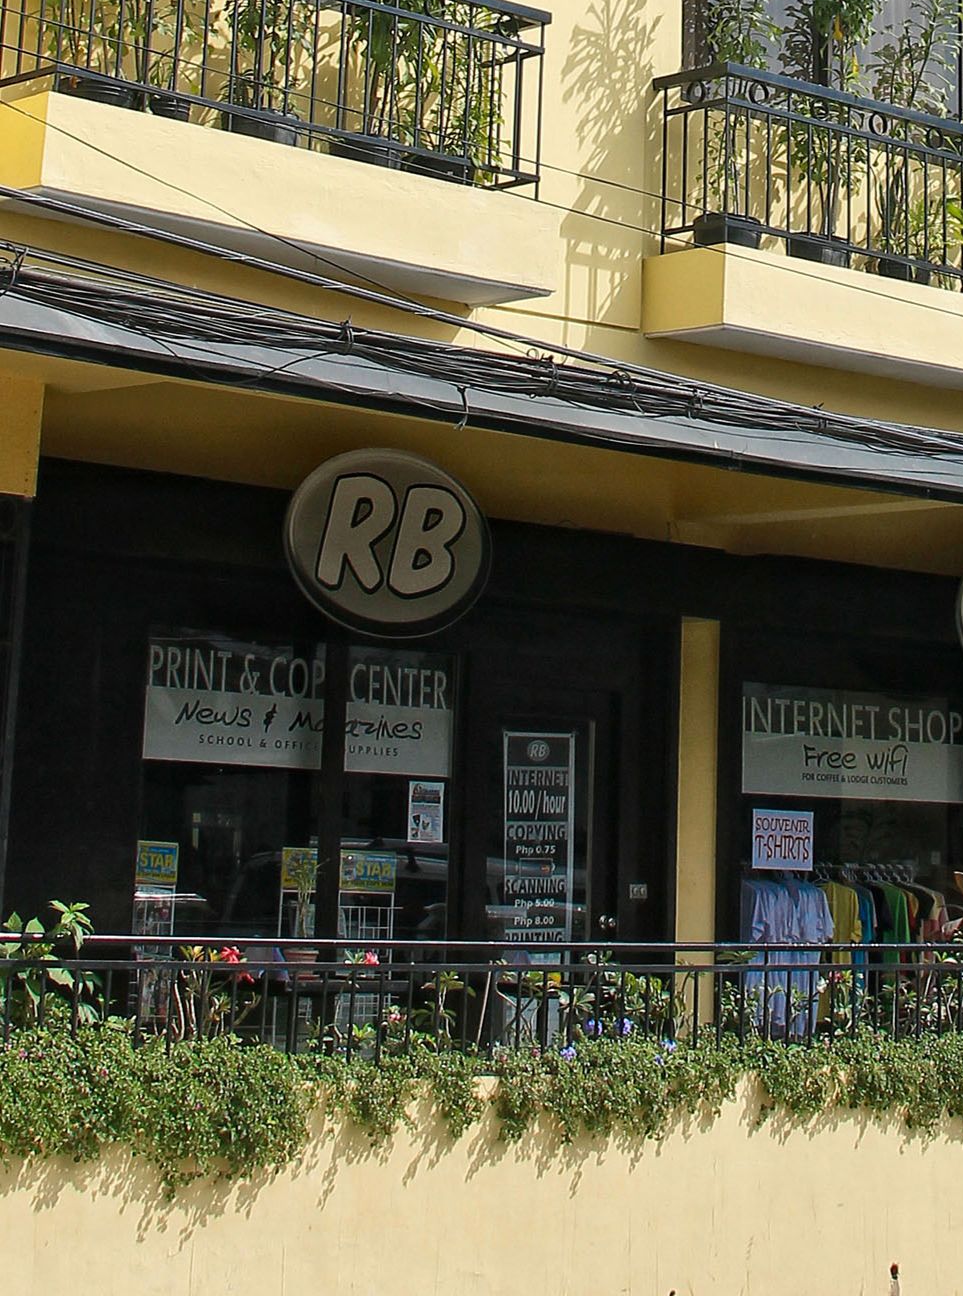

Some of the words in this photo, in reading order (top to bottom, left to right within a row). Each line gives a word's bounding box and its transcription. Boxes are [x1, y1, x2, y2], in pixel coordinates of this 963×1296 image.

[315, 472, 466, 599] RB
[150, 645, 232, 693] PRINT
[240, 655, 260, 696] &
[270, 656, 327, 700] COP
[350, 664, 447, 710] CENTER
[174, 700, 253, 729] News
[289, 711, 423, 740] Maazines
[742, 696, 880, 741] INTERNET
[888, 707, 963, 745] SHOP
[199, 734, 252, 747] SCHOOL
[260, 739, 268, 748] &
[345, 745, 400, 757] UPPLIES
[803, 744, 857, 770] Free
[508, 769, 569, 786] INTERNET
[802, 772, 815, 781] FOR
[816, 773, 839, 783] COFFEE
[847, 775, 869, 784] LODGE
[870, 776, 908, 786] CUSTOMERS
[506, 824, 568, 840] COPYING
[755, 817, 810, 833] SOUVENIR
[515, 845, 534, 856] Php
[755, 834, 810, 862] T-SHIRTS
[505, 878, 567, 894] SCANNING
[514, 899, 533, 909] Php
[514, 916, 533, 926] Php
[534, 916, 554, 925] 8.00
